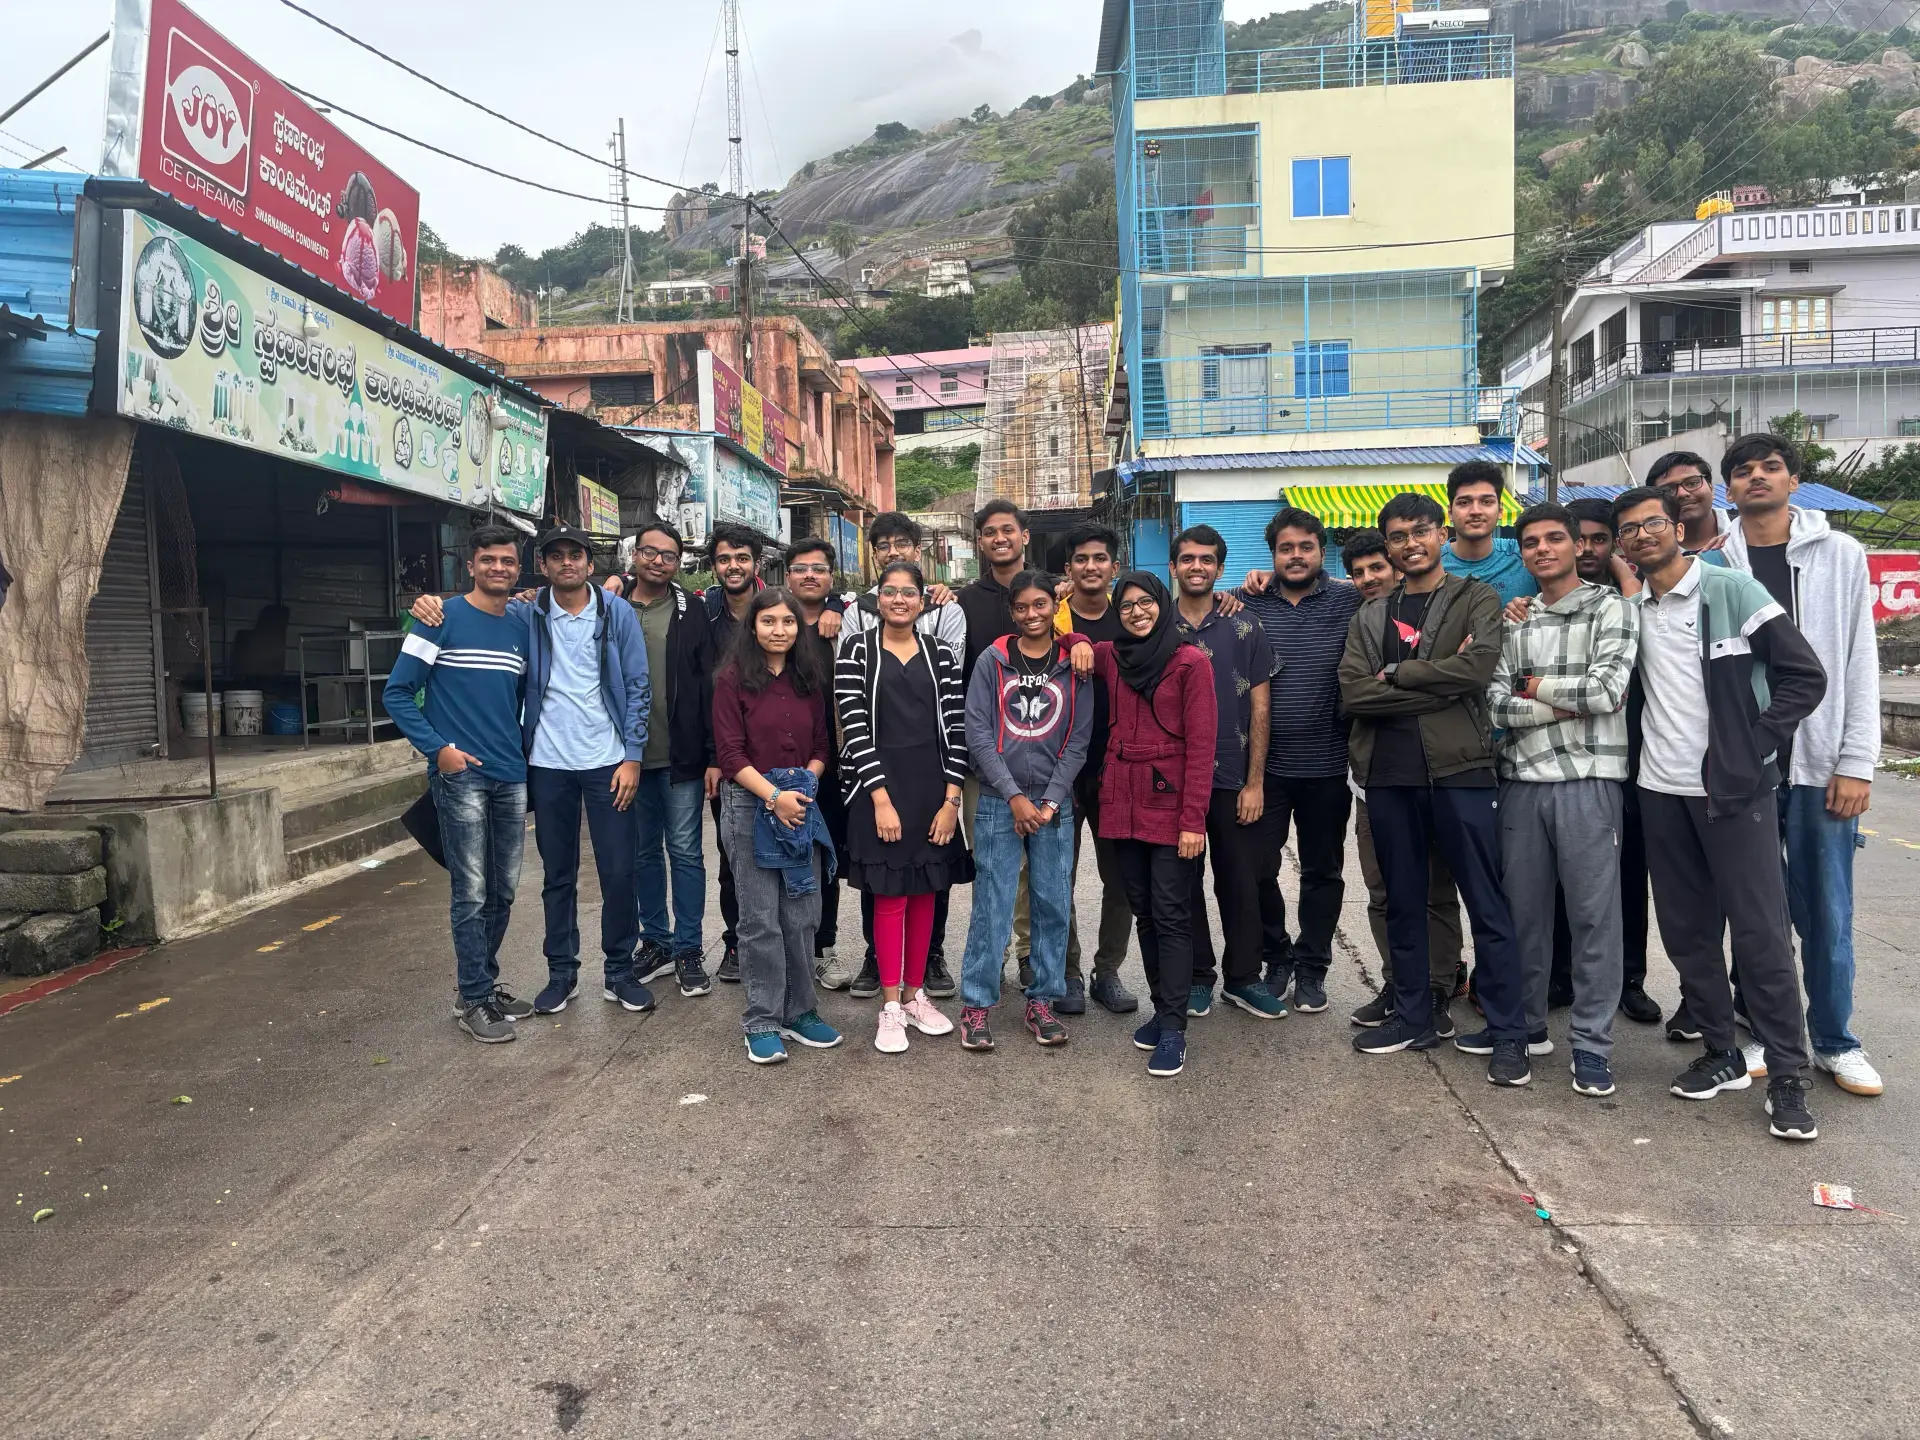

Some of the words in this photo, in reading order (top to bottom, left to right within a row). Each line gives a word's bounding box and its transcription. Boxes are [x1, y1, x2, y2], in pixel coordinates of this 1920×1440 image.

[1440, 20, 1464, 28] SELCO
[181, 85, 237, 149] JOY
[159, 154, 183, 183] ICE
[185, 170, 245, 218] CREAMS
[254, 206, 295, 240] SWARNAMBHA
[295, 230, 330, 260] CONDIMENTS
[199, 278, 242, 357] ಶ್ರೀ
